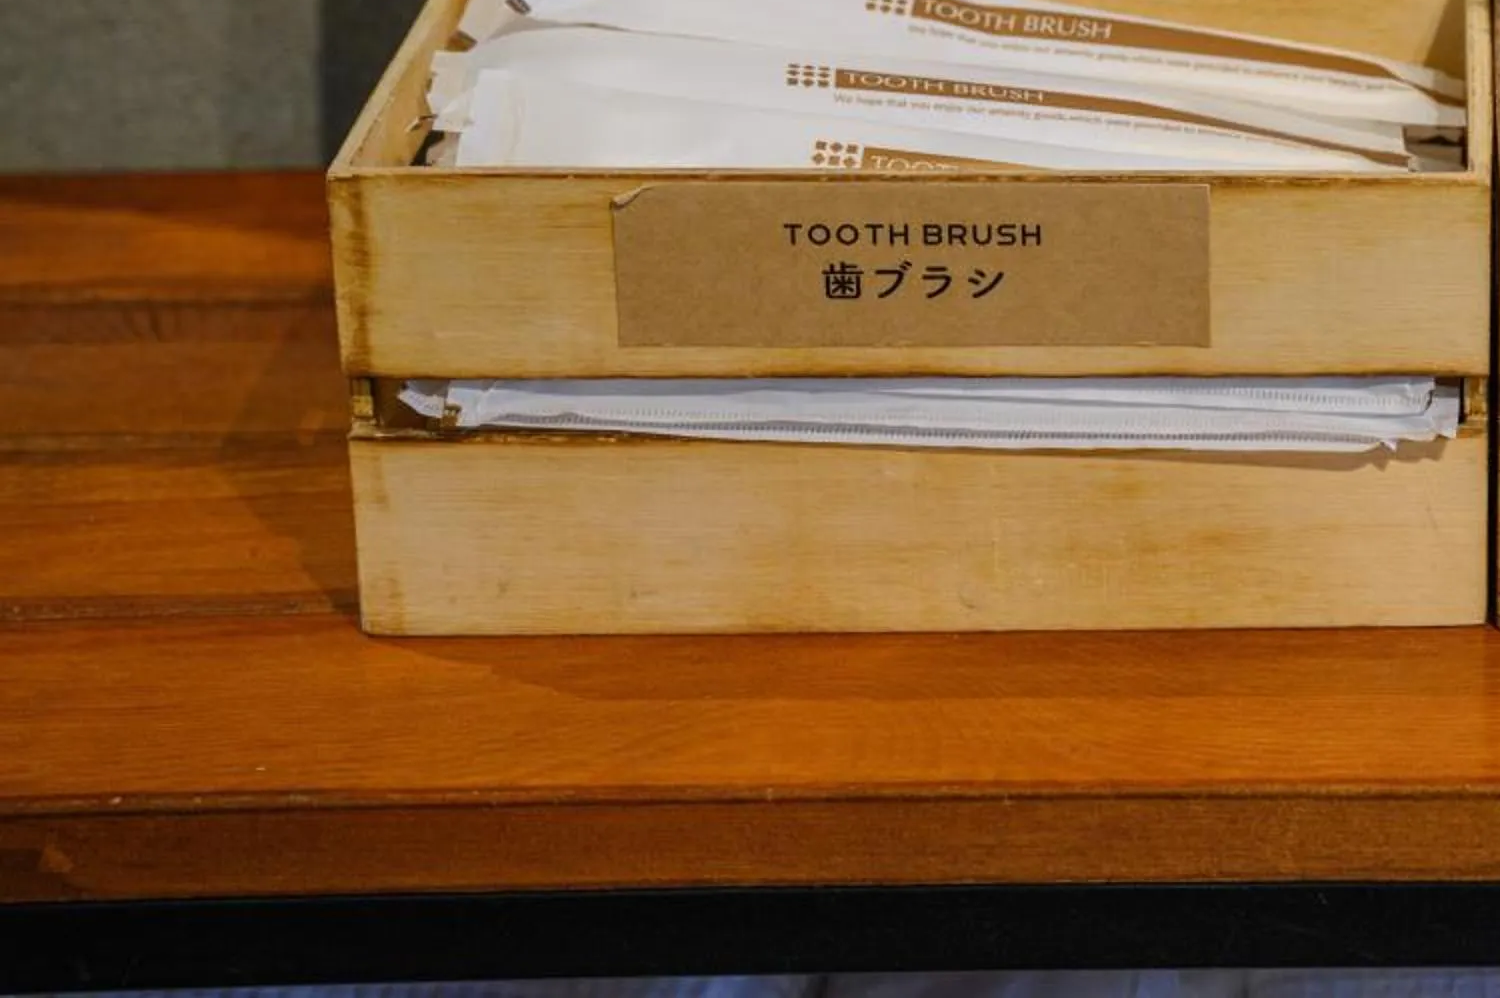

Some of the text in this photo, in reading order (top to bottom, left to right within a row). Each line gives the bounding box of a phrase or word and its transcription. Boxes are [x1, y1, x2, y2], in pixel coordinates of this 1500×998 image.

[1024, 14, 1113, 39] BRUSH
[844, 72, 1044, 102] TOOTH BRUSH
[784, 223, 1042, 247] TOOTH BRUSH
[822, 260, 1005, 300] 歯ブラシ
